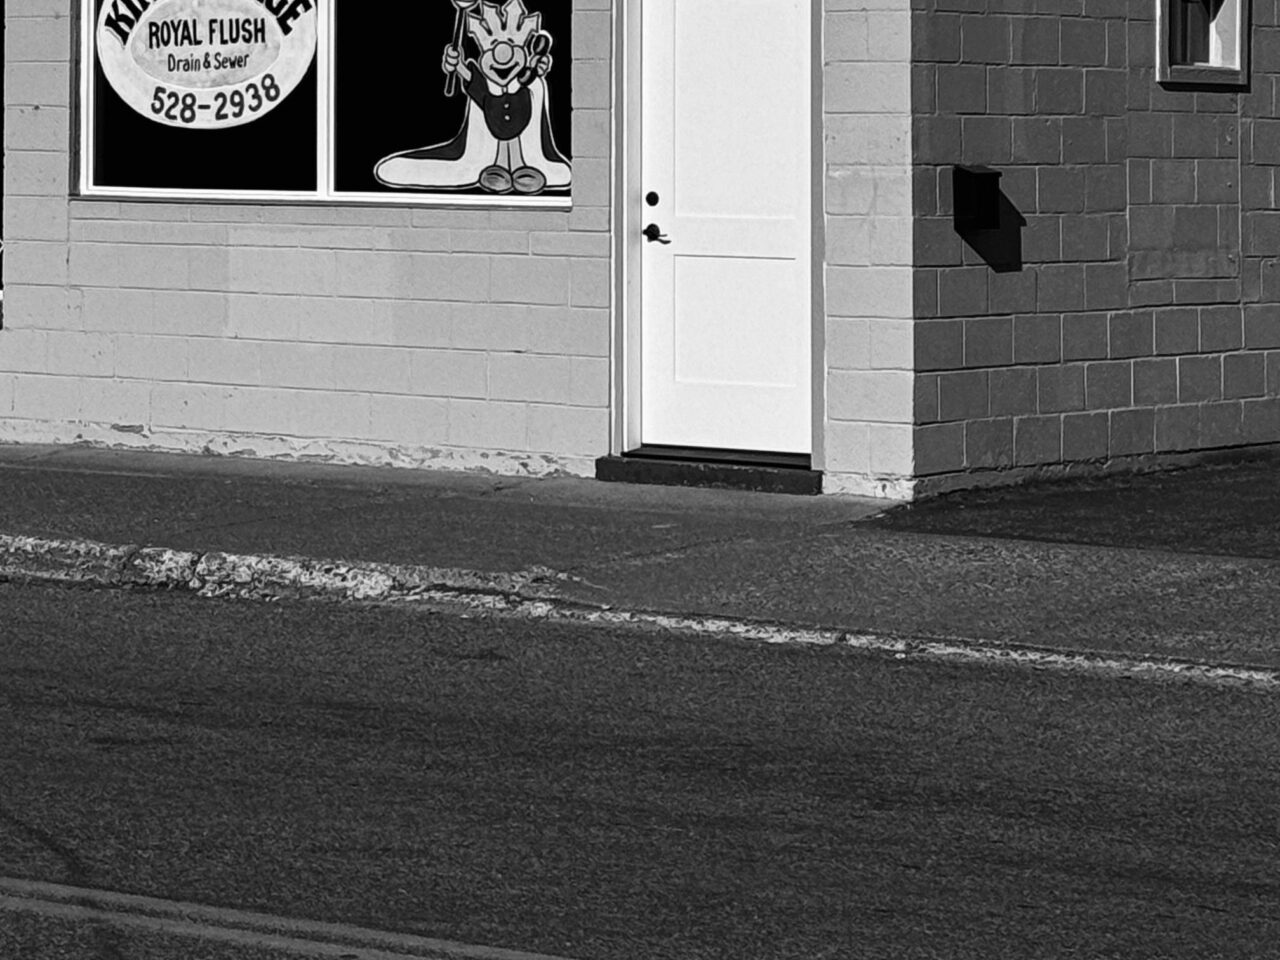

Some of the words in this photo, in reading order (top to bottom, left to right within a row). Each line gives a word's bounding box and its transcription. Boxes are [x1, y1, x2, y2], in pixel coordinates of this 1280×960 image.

[148, 19, 203, 49] ROYAL
[208, 18, 266, 45] FLUSH
[167, 53, 201, 72] Drain
[202, 54, 211, 69] &
[214, 52, 250, 70] Sewer
[151, 73, 281, 123] 528-2938
